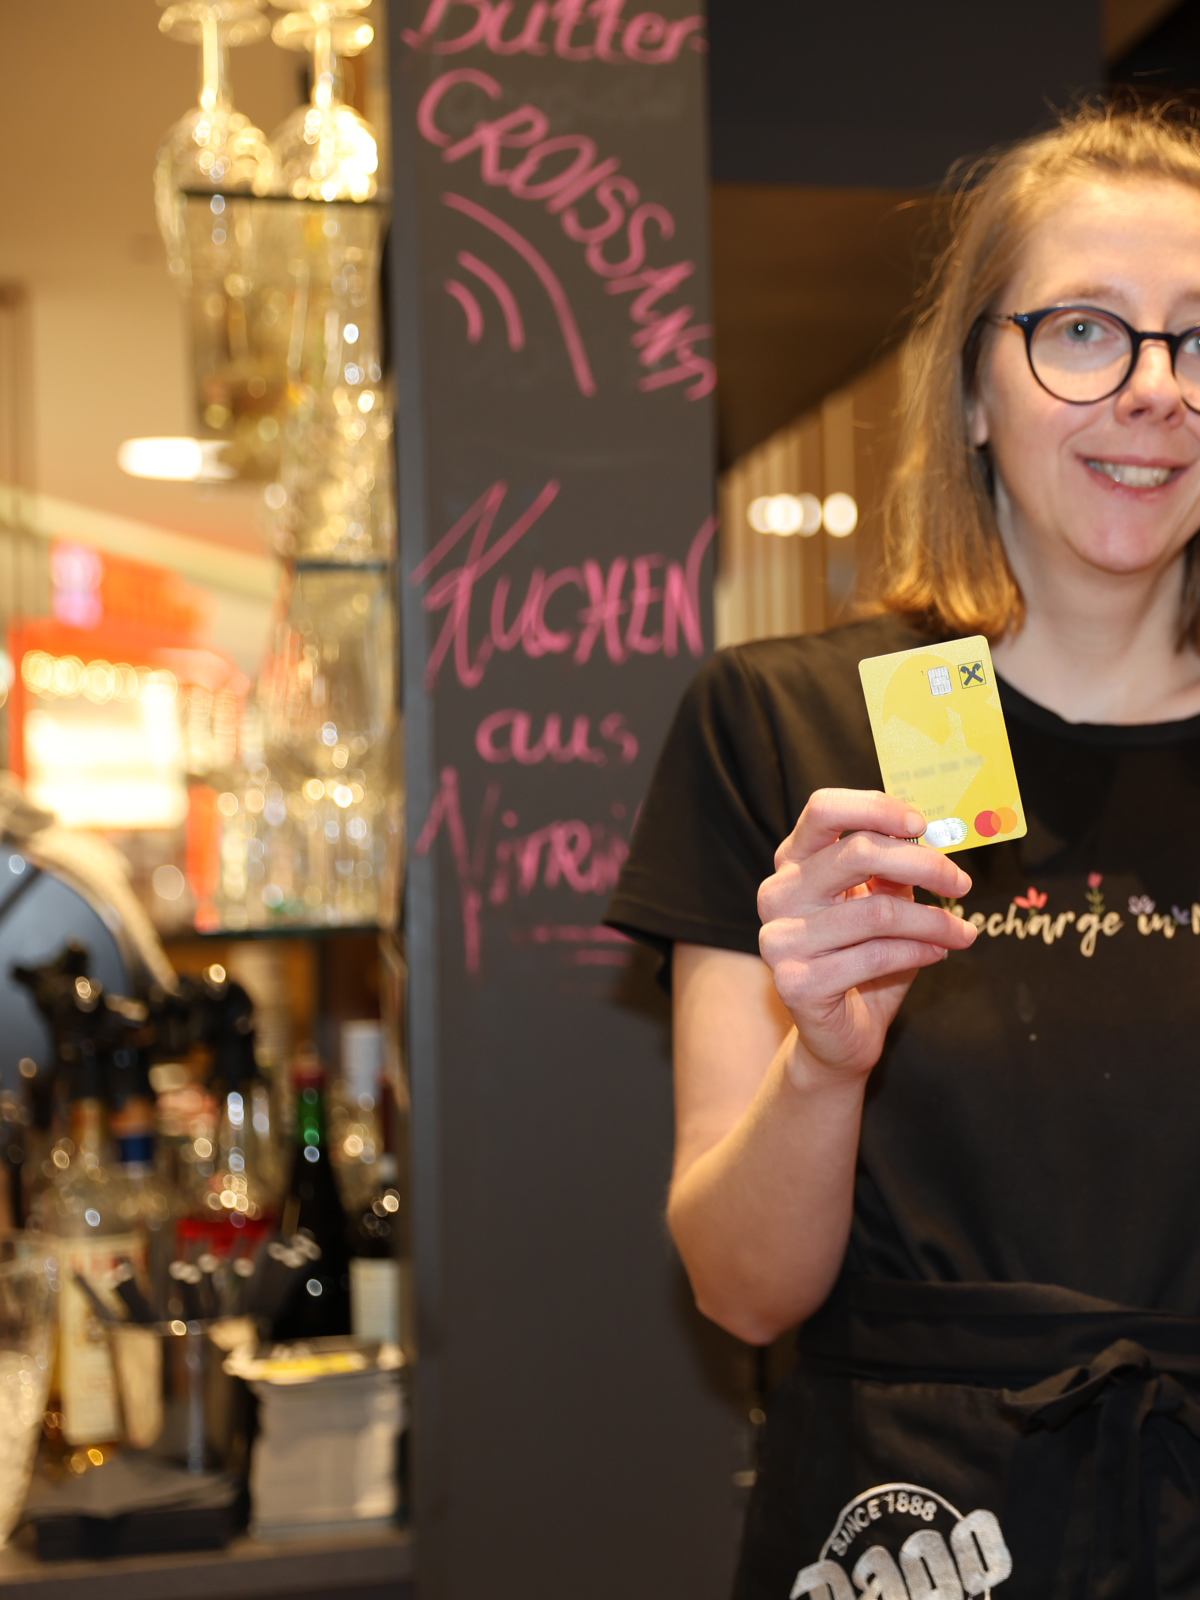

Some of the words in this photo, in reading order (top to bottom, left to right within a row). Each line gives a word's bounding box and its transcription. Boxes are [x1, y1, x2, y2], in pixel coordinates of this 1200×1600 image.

[475, 708, 639, 766] aus
[930, 824, 960, 841] debit
[1137, 911, 1177, 939] in
[831, 1498, 882, 1557] SINCE
[884, 1491, 938, 1522] 1888
